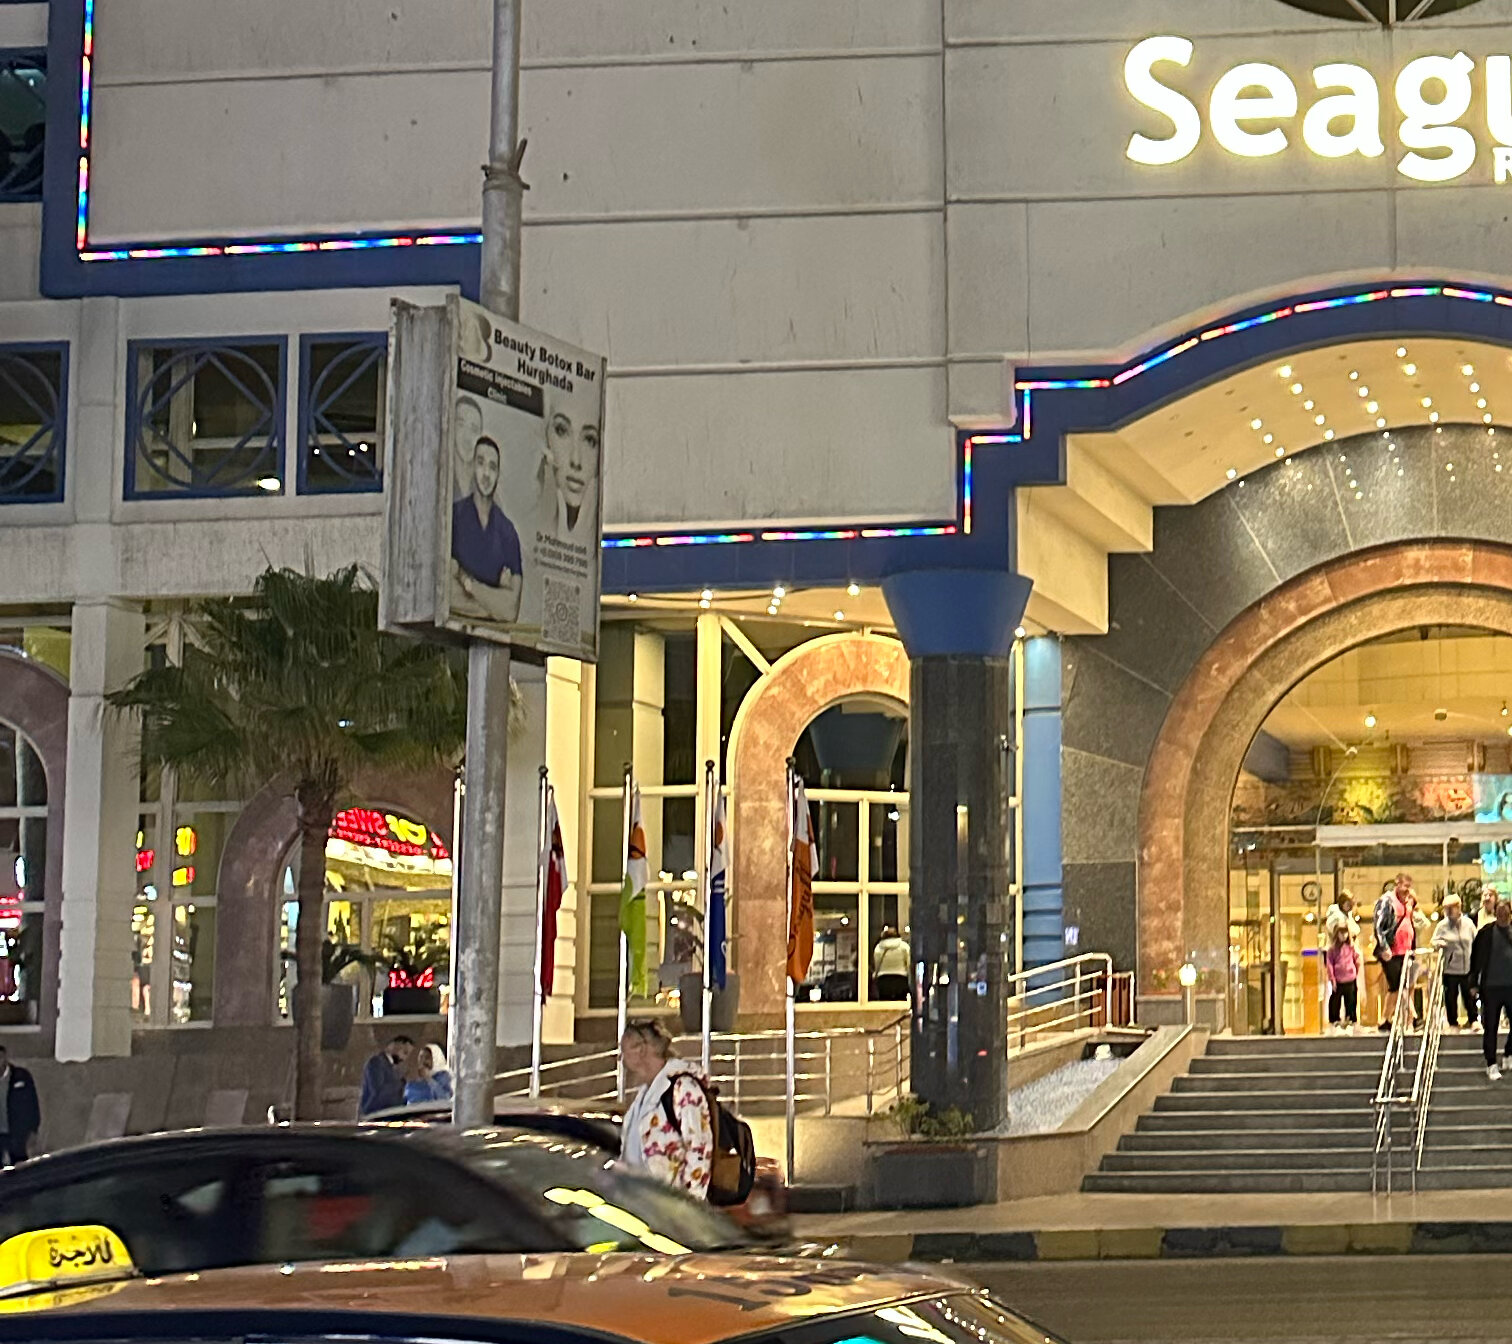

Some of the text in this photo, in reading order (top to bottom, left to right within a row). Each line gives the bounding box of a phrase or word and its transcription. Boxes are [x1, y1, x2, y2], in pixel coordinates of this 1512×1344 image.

[494, 328, 595, 381] Beauty Botox Bar
[517, 358, 573, 392] Hurghada
